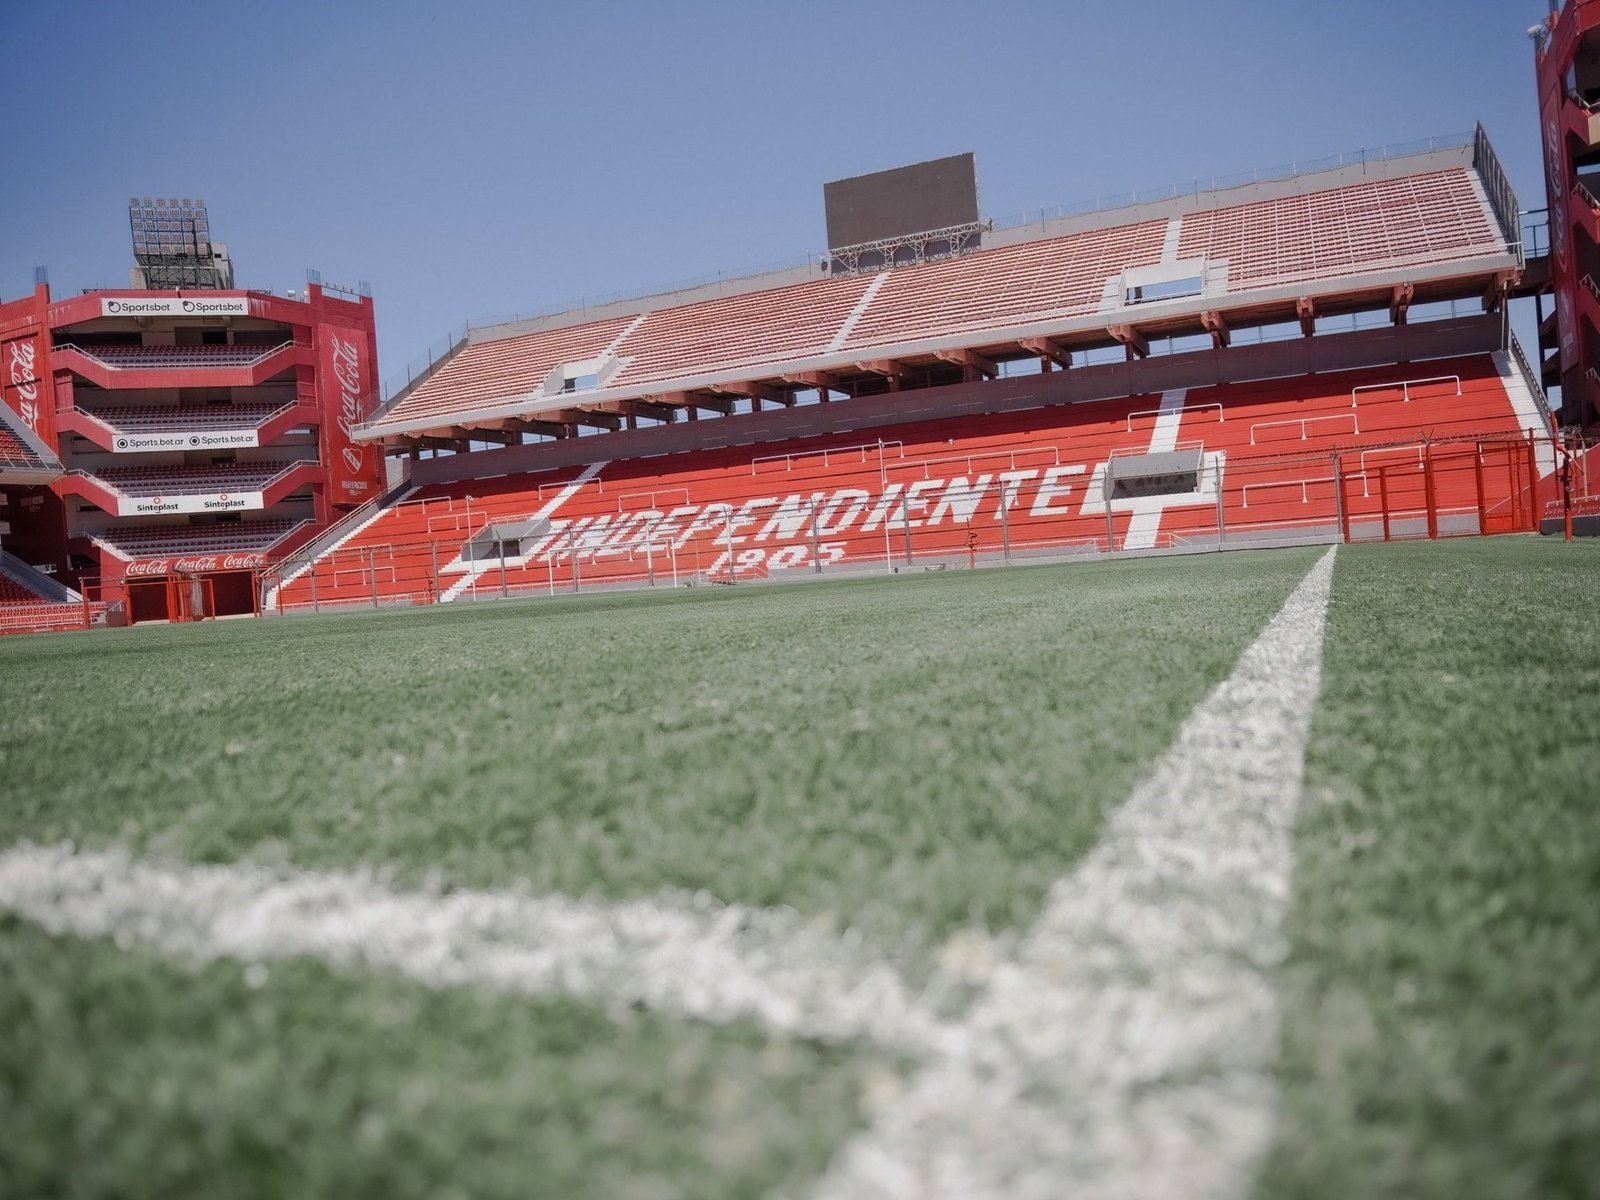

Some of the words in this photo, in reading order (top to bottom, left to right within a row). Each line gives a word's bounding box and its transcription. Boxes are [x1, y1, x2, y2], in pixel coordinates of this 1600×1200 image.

[122, 303, 170, 313] Sportsbet
[196, 302, 243, 312] Sportsbet
[137, 503, 179, 513] Sinteplast
[204, 500, 245, 510] Sinteplast
[537, 464, 1086, 562] INDEPENDIENTE
[706, 541, 847, 575] 1905
